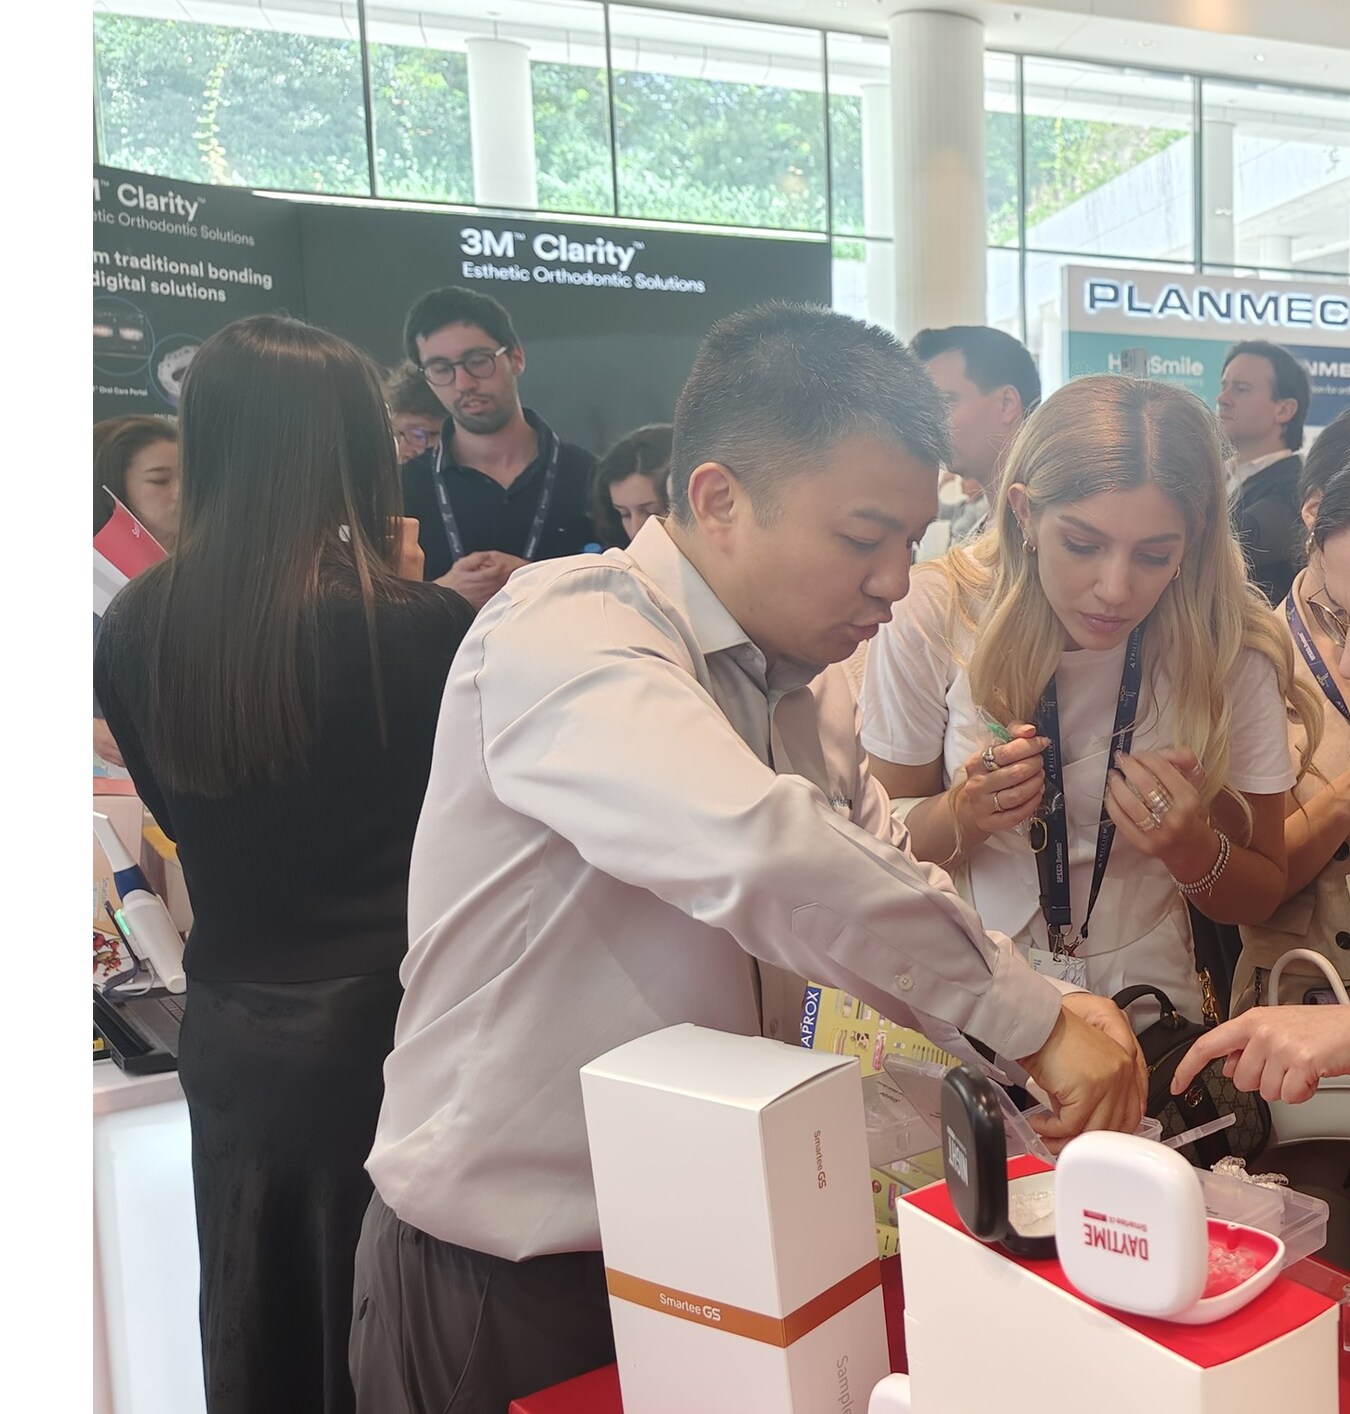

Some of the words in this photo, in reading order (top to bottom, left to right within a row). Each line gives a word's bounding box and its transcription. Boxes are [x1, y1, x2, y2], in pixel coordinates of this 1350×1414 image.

[118, 211, 198, 238] Orthodontic
[200, 224, 255, 247] Solutions
[114, 250, 204, 279] traditional
[208, 262, 272, 290] bonding
[462, 261, 530, 282] Esthetic
[532, 265, 633, 289] Orthodontic
[634, 273, 706, 294] Solutions
[151, 279, 227, 302] solutions
[801, 990, 819, 1048] APROX
[813, 1129, 823, 1171] Smartee
[1083, 1223, 1149, 1261] DAYTIME
[659, 1293, 701, 1315] Smartee
